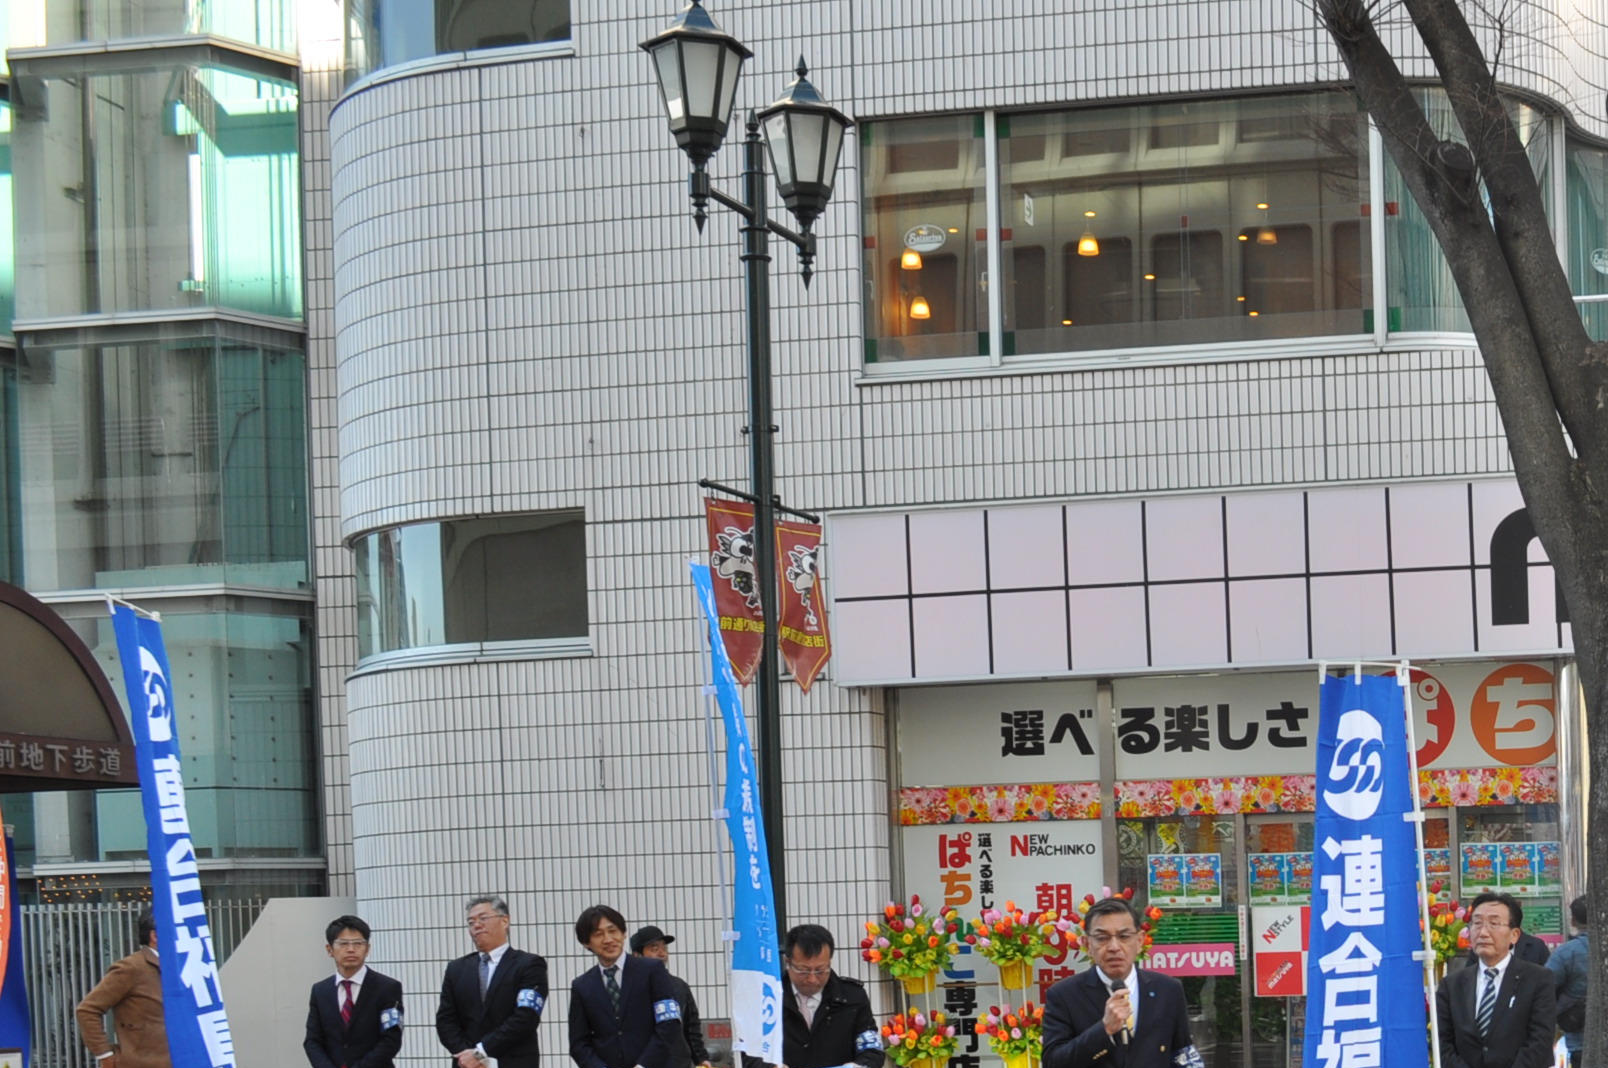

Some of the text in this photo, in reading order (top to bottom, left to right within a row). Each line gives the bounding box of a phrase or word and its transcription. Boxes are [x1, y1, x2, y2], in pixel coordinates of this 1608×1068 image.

[1001, 701, 1309, 757] 選べる楽しさ
[1010, 834, 1049, 857] NEW
[1029, 843, 1096, 857] PACHINKO
[977, 832, 995, 916] 選べる楽し
